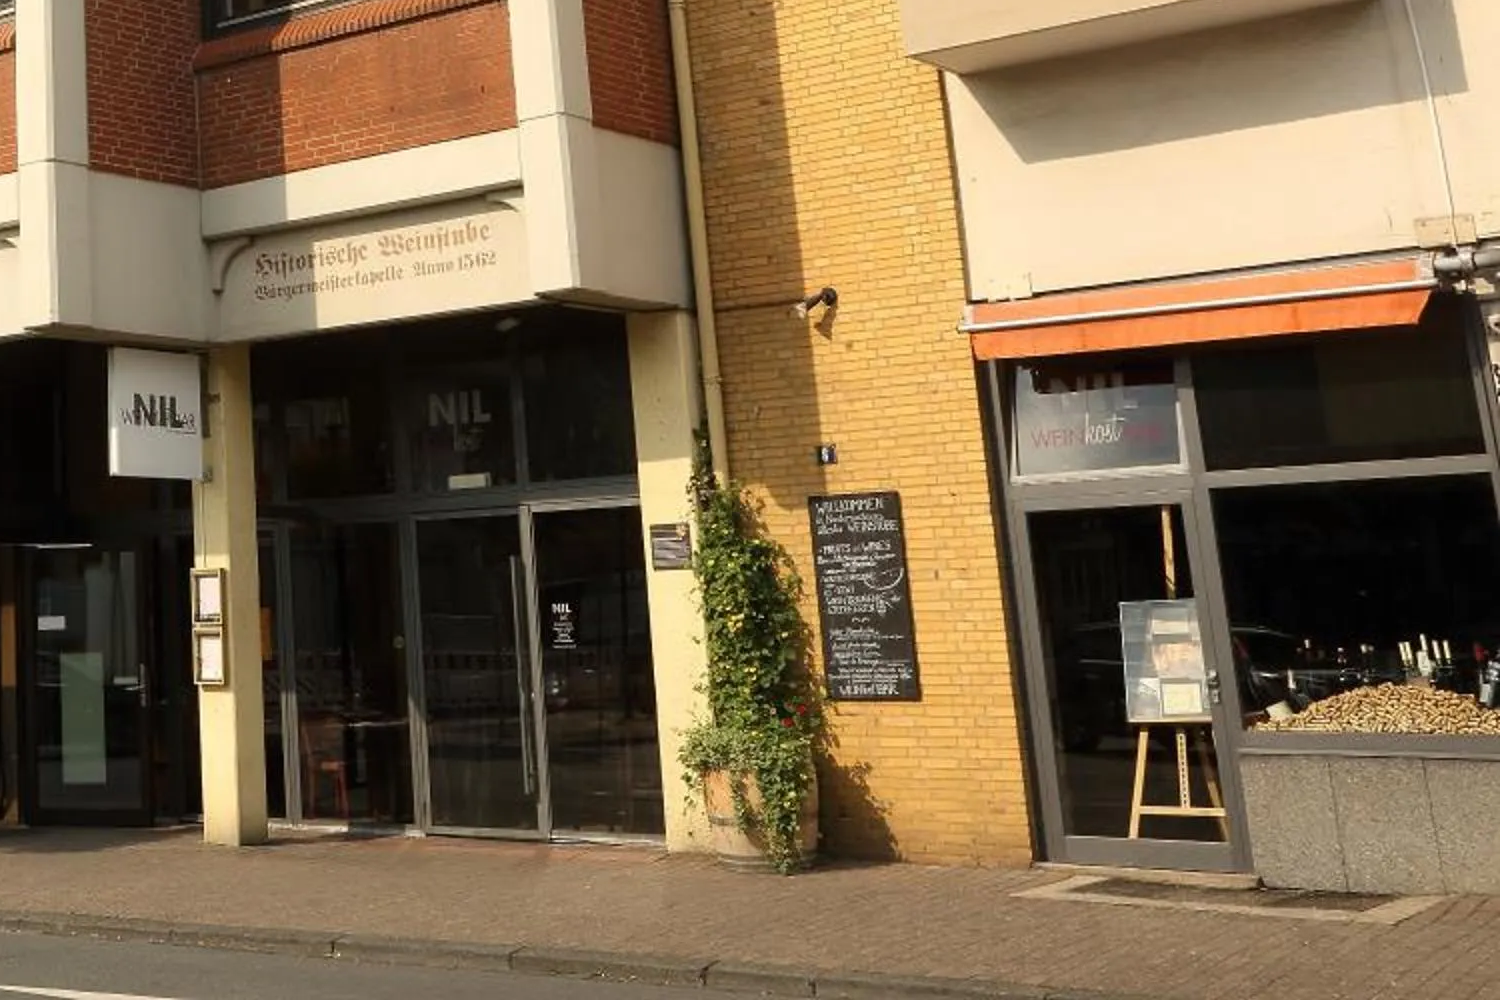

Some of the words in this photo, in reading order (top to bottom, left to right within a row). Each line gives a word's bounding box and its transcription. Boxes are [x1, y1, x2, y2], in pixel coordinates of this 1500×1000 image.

[412, 259, 453, 278] Anno
[457, 251, 497, 271] 1562
[133, 393, 184, 428] NIL
[428, 391, 492, 426] NIL
[551, 603, 572, 613] NIL
